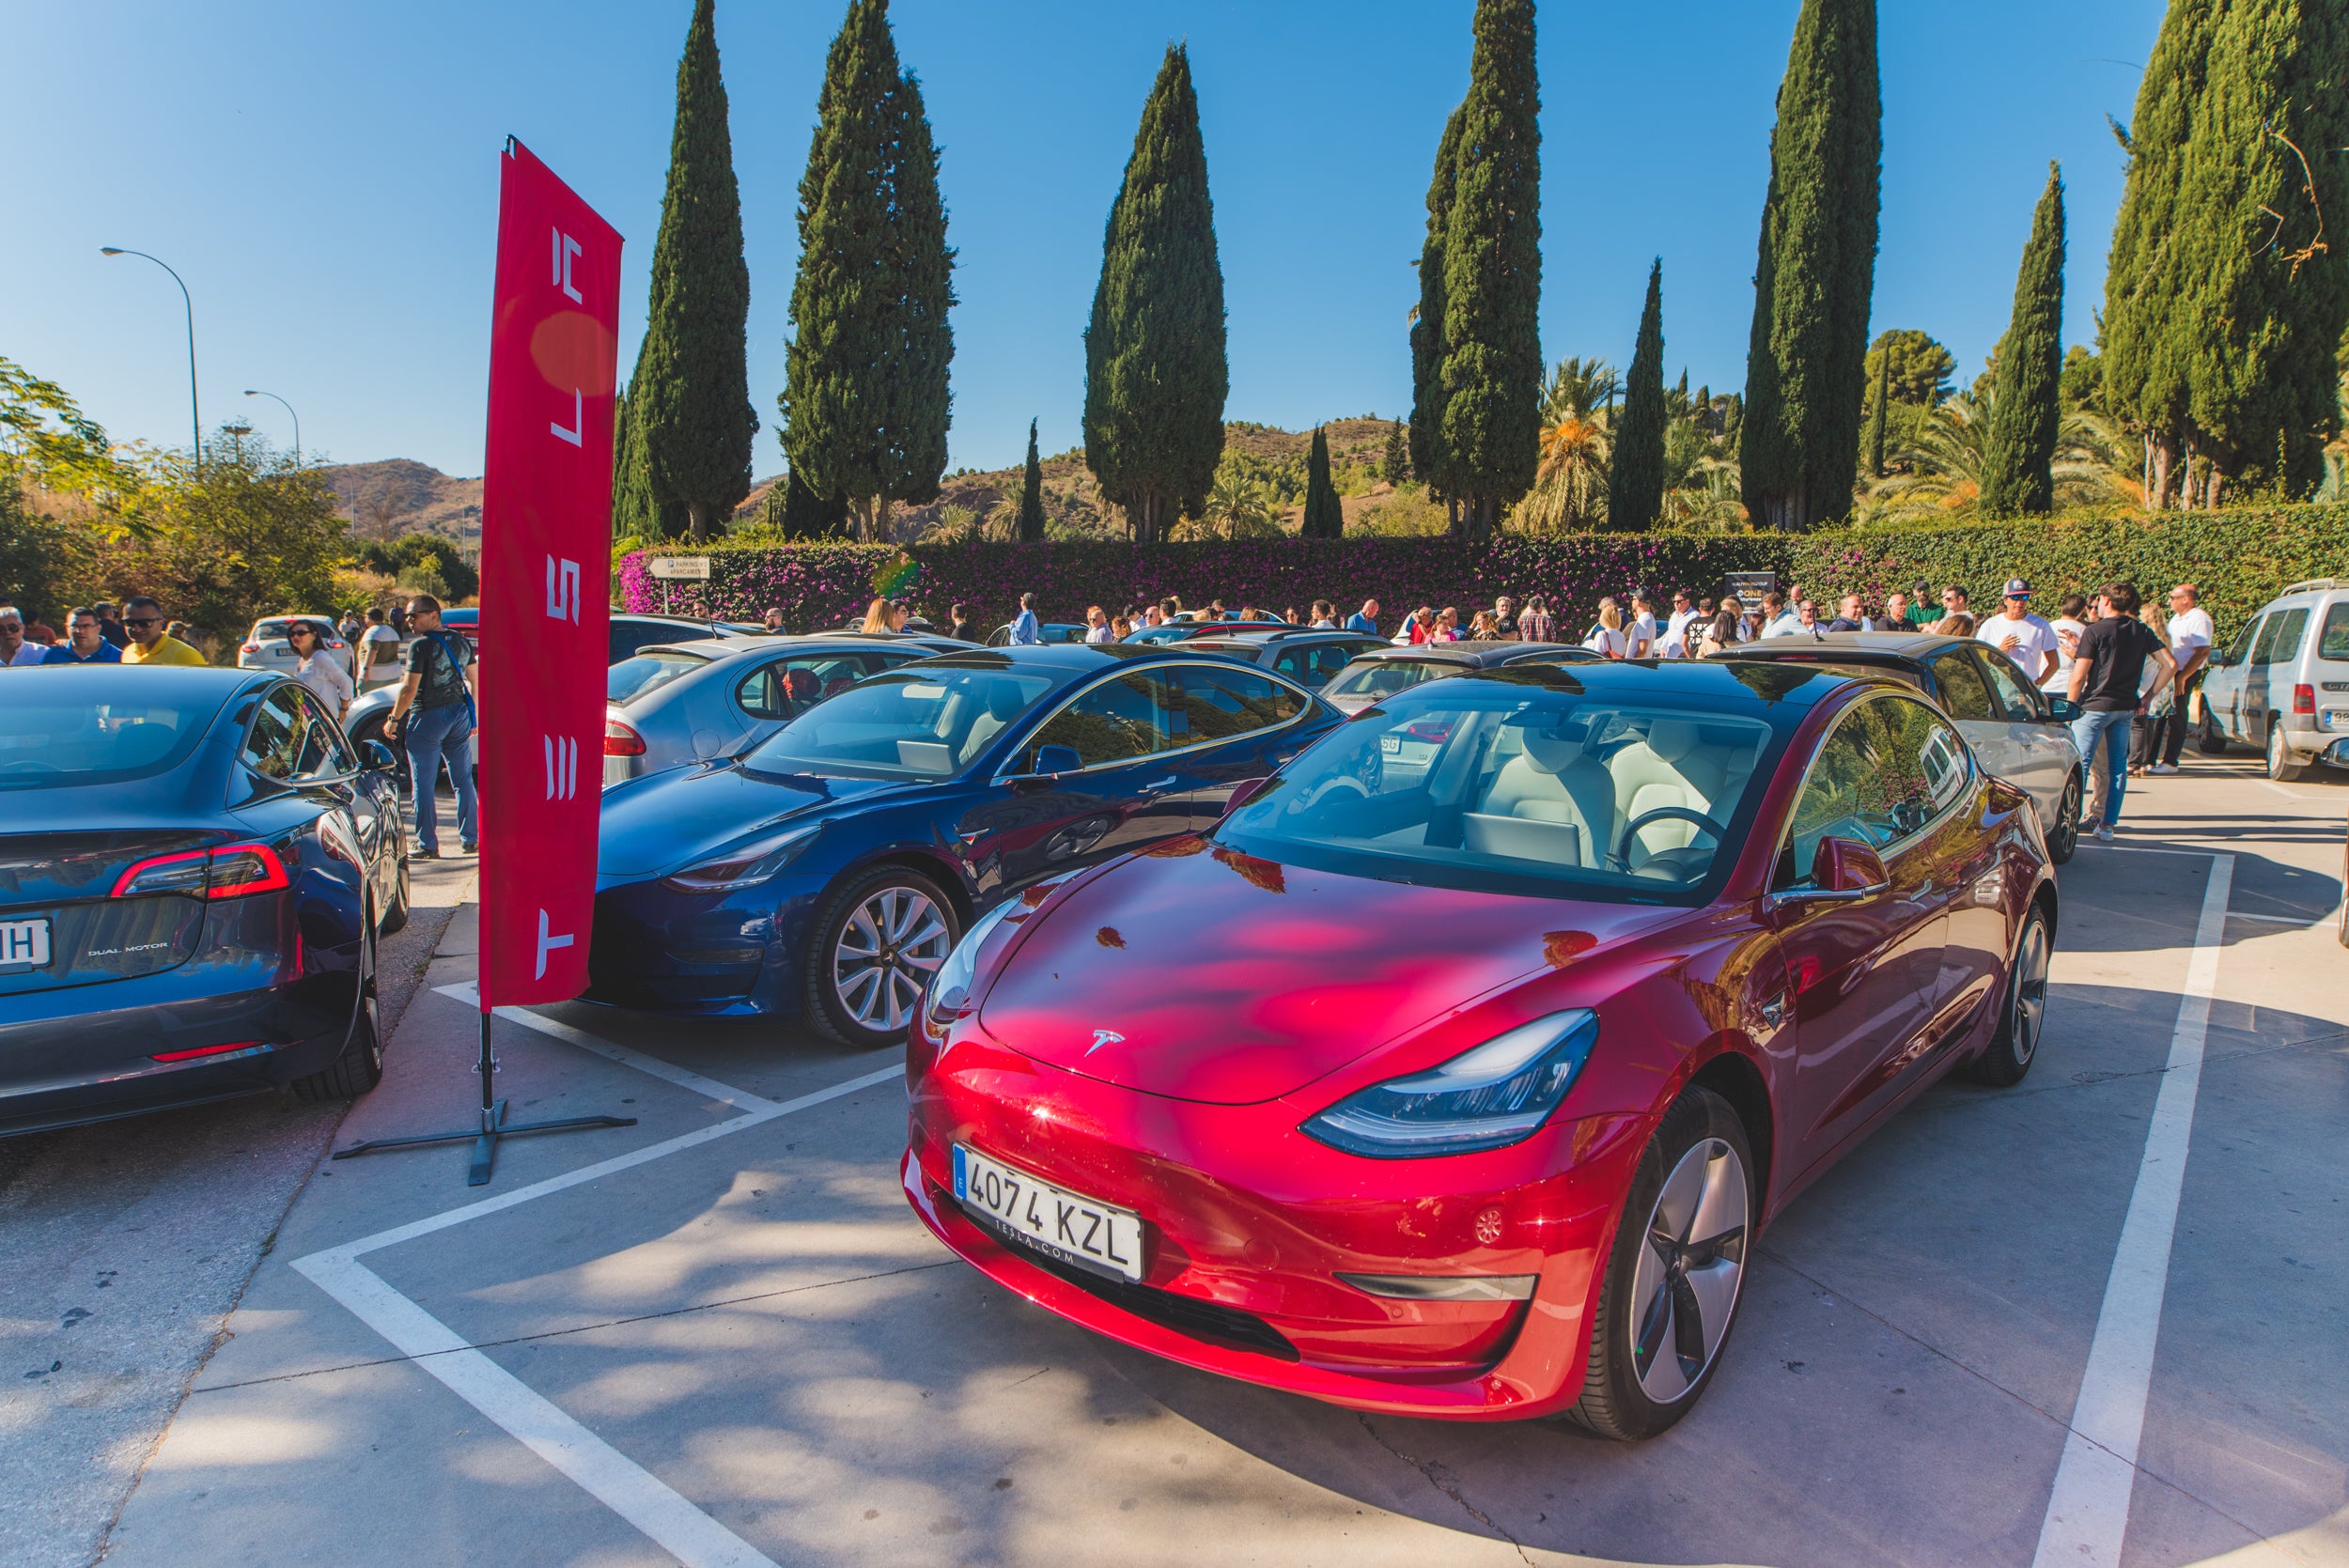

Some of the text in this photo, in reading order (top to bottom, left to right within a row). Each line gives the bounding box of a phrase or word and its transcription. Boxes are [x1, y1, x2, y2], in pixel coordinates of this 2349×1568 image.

[535, 225, 583, 981] TESLA
[1743, 589, 1763, 598] ONE
[1381, 737, 1396, 750] SG
[0, 926, 34, 960] H
[87, 941, 169, 957] DUAL MOTOR
[970, 1162, 1128, 1266] 4074 KZL
[994, 1219, 1075, 1265] TESLA.COM
